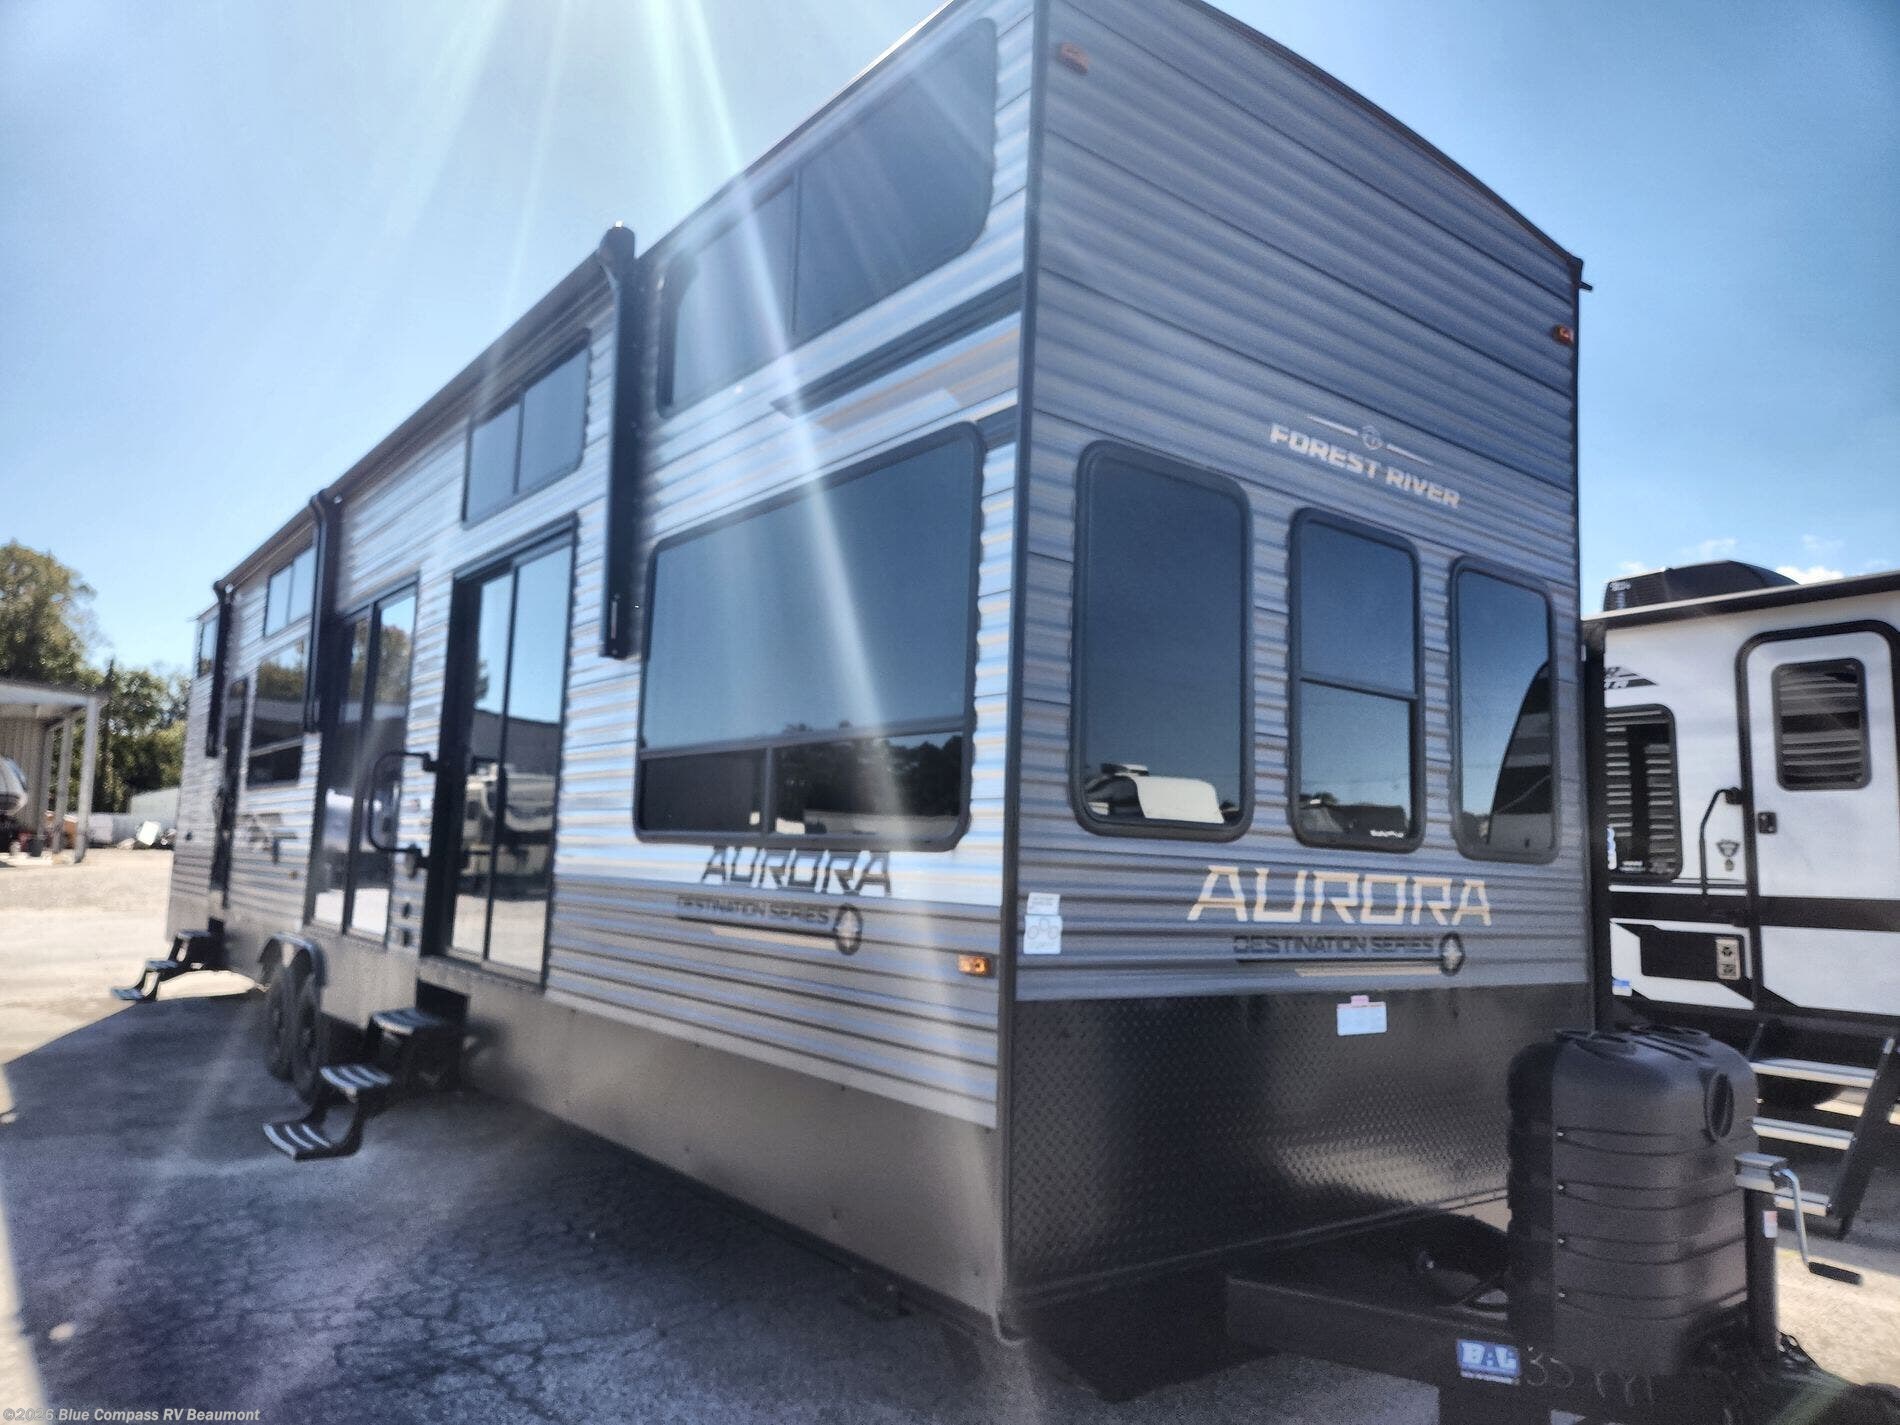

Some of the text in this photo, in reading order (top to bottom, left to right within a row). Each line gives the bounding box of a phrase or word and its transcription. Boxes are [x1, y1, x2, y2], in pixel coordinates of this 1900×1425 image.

[1270, 423, 1461, 508] FOREST RIVER
[701, 845, 892, 896] AURORA
[1187, 865, 1492, 926] AURORA
[676, 896, 831, 924] DESTINATION SERIES
[1233, 934, 1434, 954] DESTINATION SERIES
